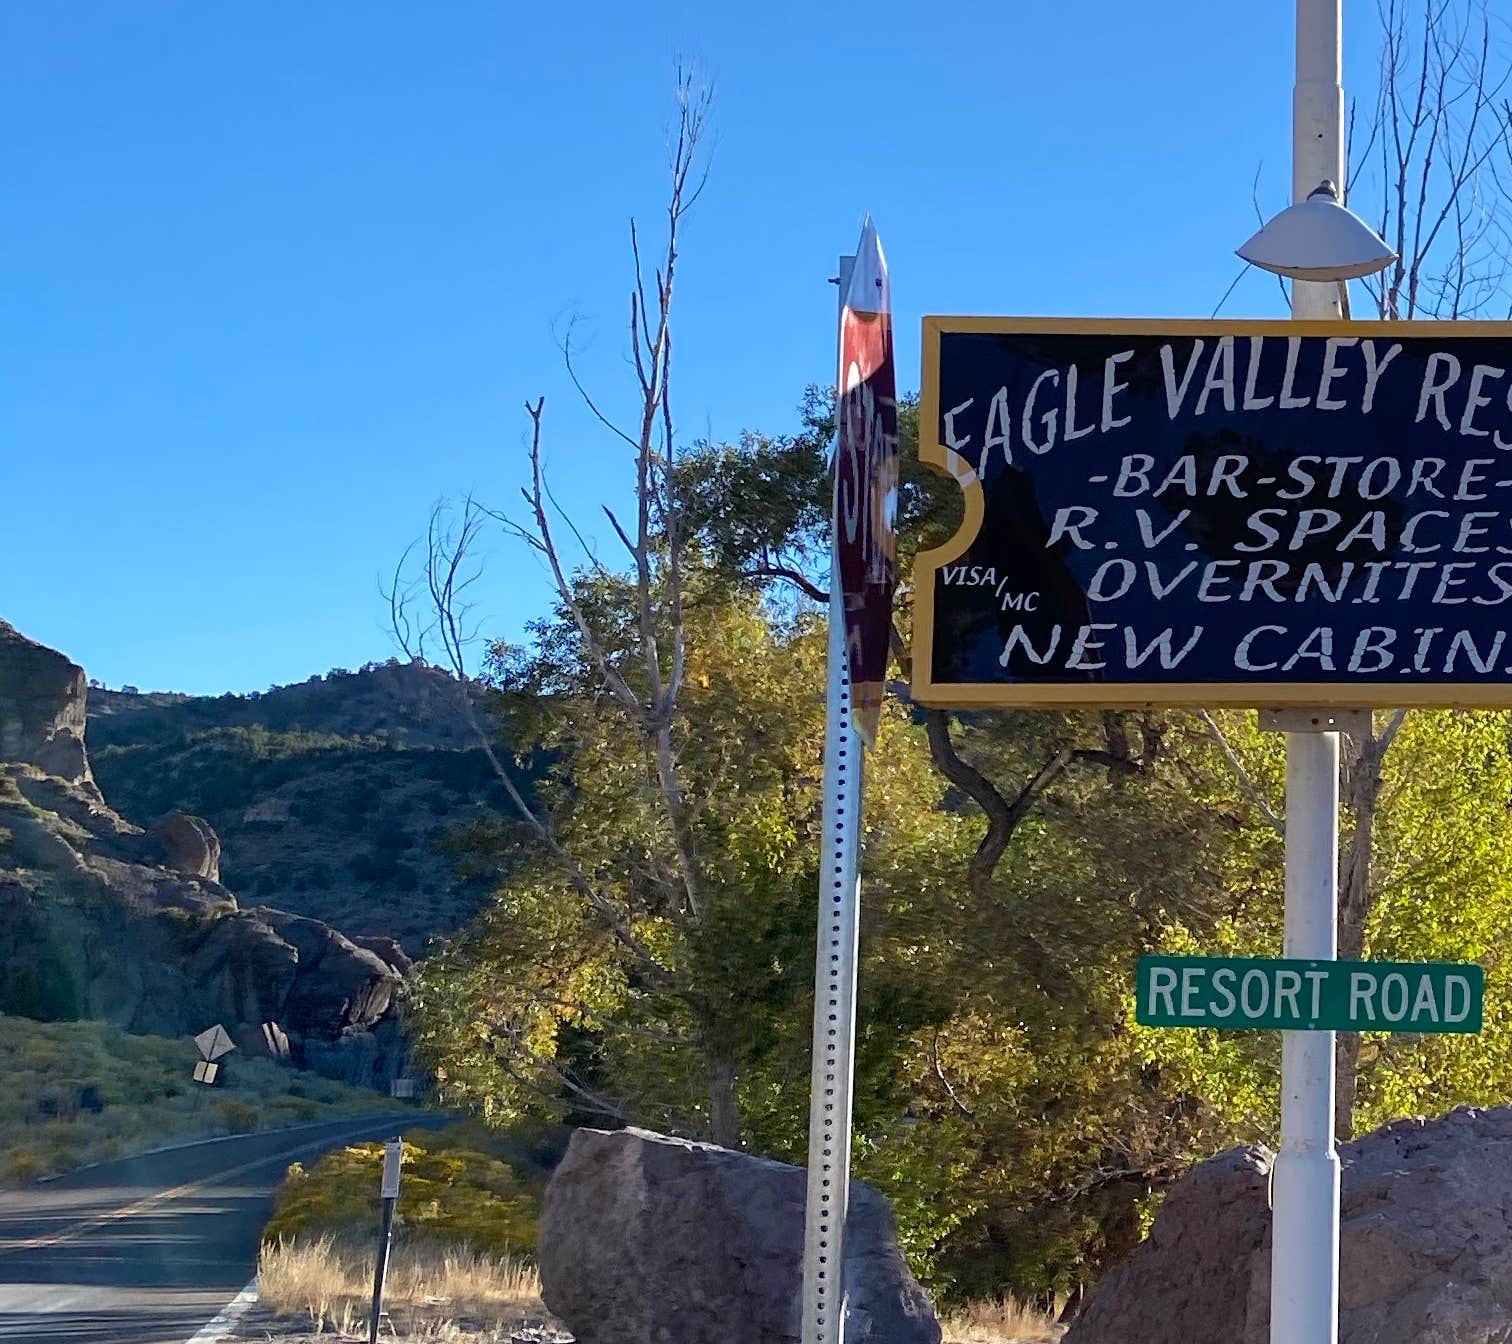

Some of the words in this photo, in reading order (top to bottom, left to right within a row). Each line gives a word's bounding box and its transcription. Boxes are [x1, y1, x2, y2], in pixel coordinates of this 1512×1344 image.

[943, 348, 1135, 487] EAGLE
[1159, 335, 1403, 421] VALLEY
[1045, 505, 1200, 551] R.V.
[998, 623, 1204, 670] NEW
[1148, 966, 1329, 1020] RESORT
[1350, 971, 1472, 1023] ROAD
